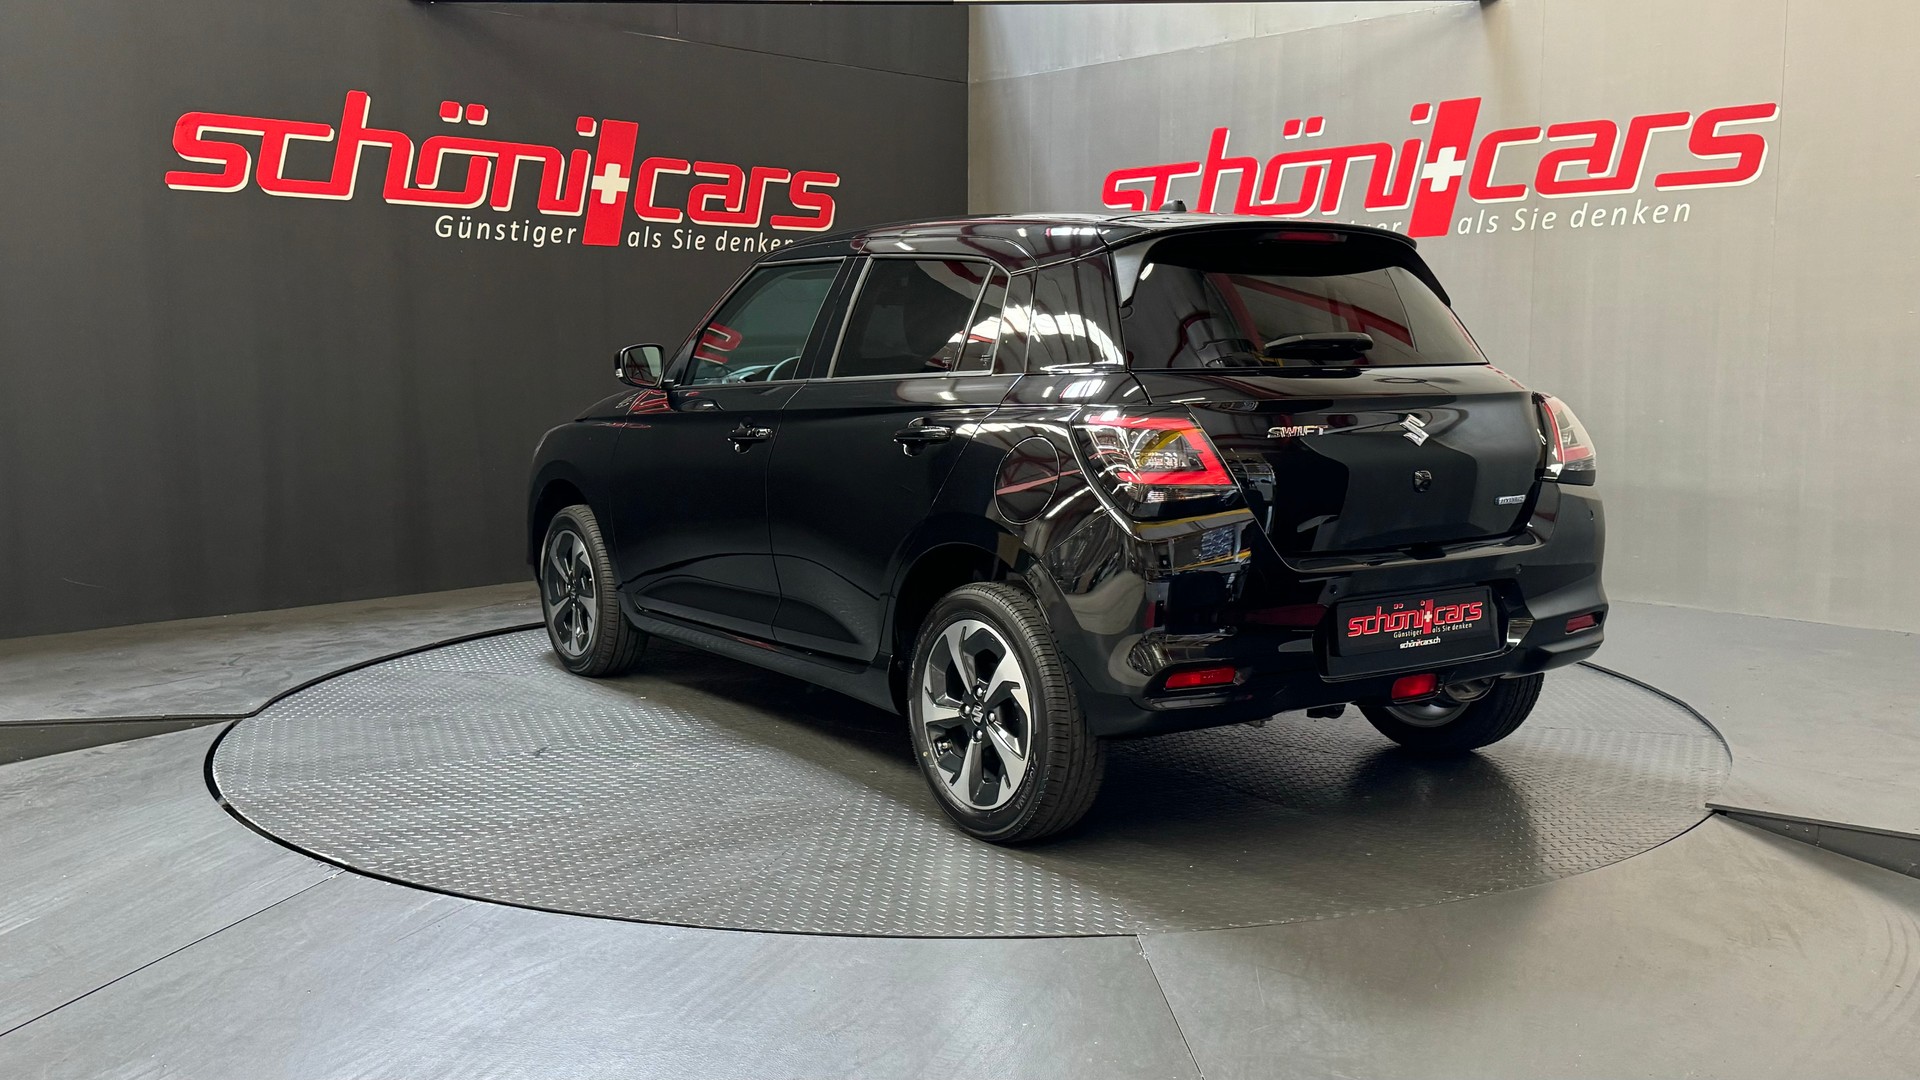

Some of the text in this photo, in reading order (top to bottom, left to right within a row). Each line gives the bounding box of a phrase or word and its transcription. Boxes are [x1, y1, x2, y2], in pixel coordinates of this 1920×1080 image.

[1467, 102, 1778, 204] cars
[634, 157, 841, 232] cars
[434, 214, 577, 248] Günstiger
[627, 228, 662, 249] als
[672, 229, 706, 251] Sie
[1456, 201, 1692, 236] als Sie denken
[1267, 424, 1328, 439] SWIFT
[1393, 629, 1423, 639] Günstiger
[1442, 624, 1451, 632] Sie
[1451, 622, 1473, 631] denken
[1433, 602, 1483, 625] cars
